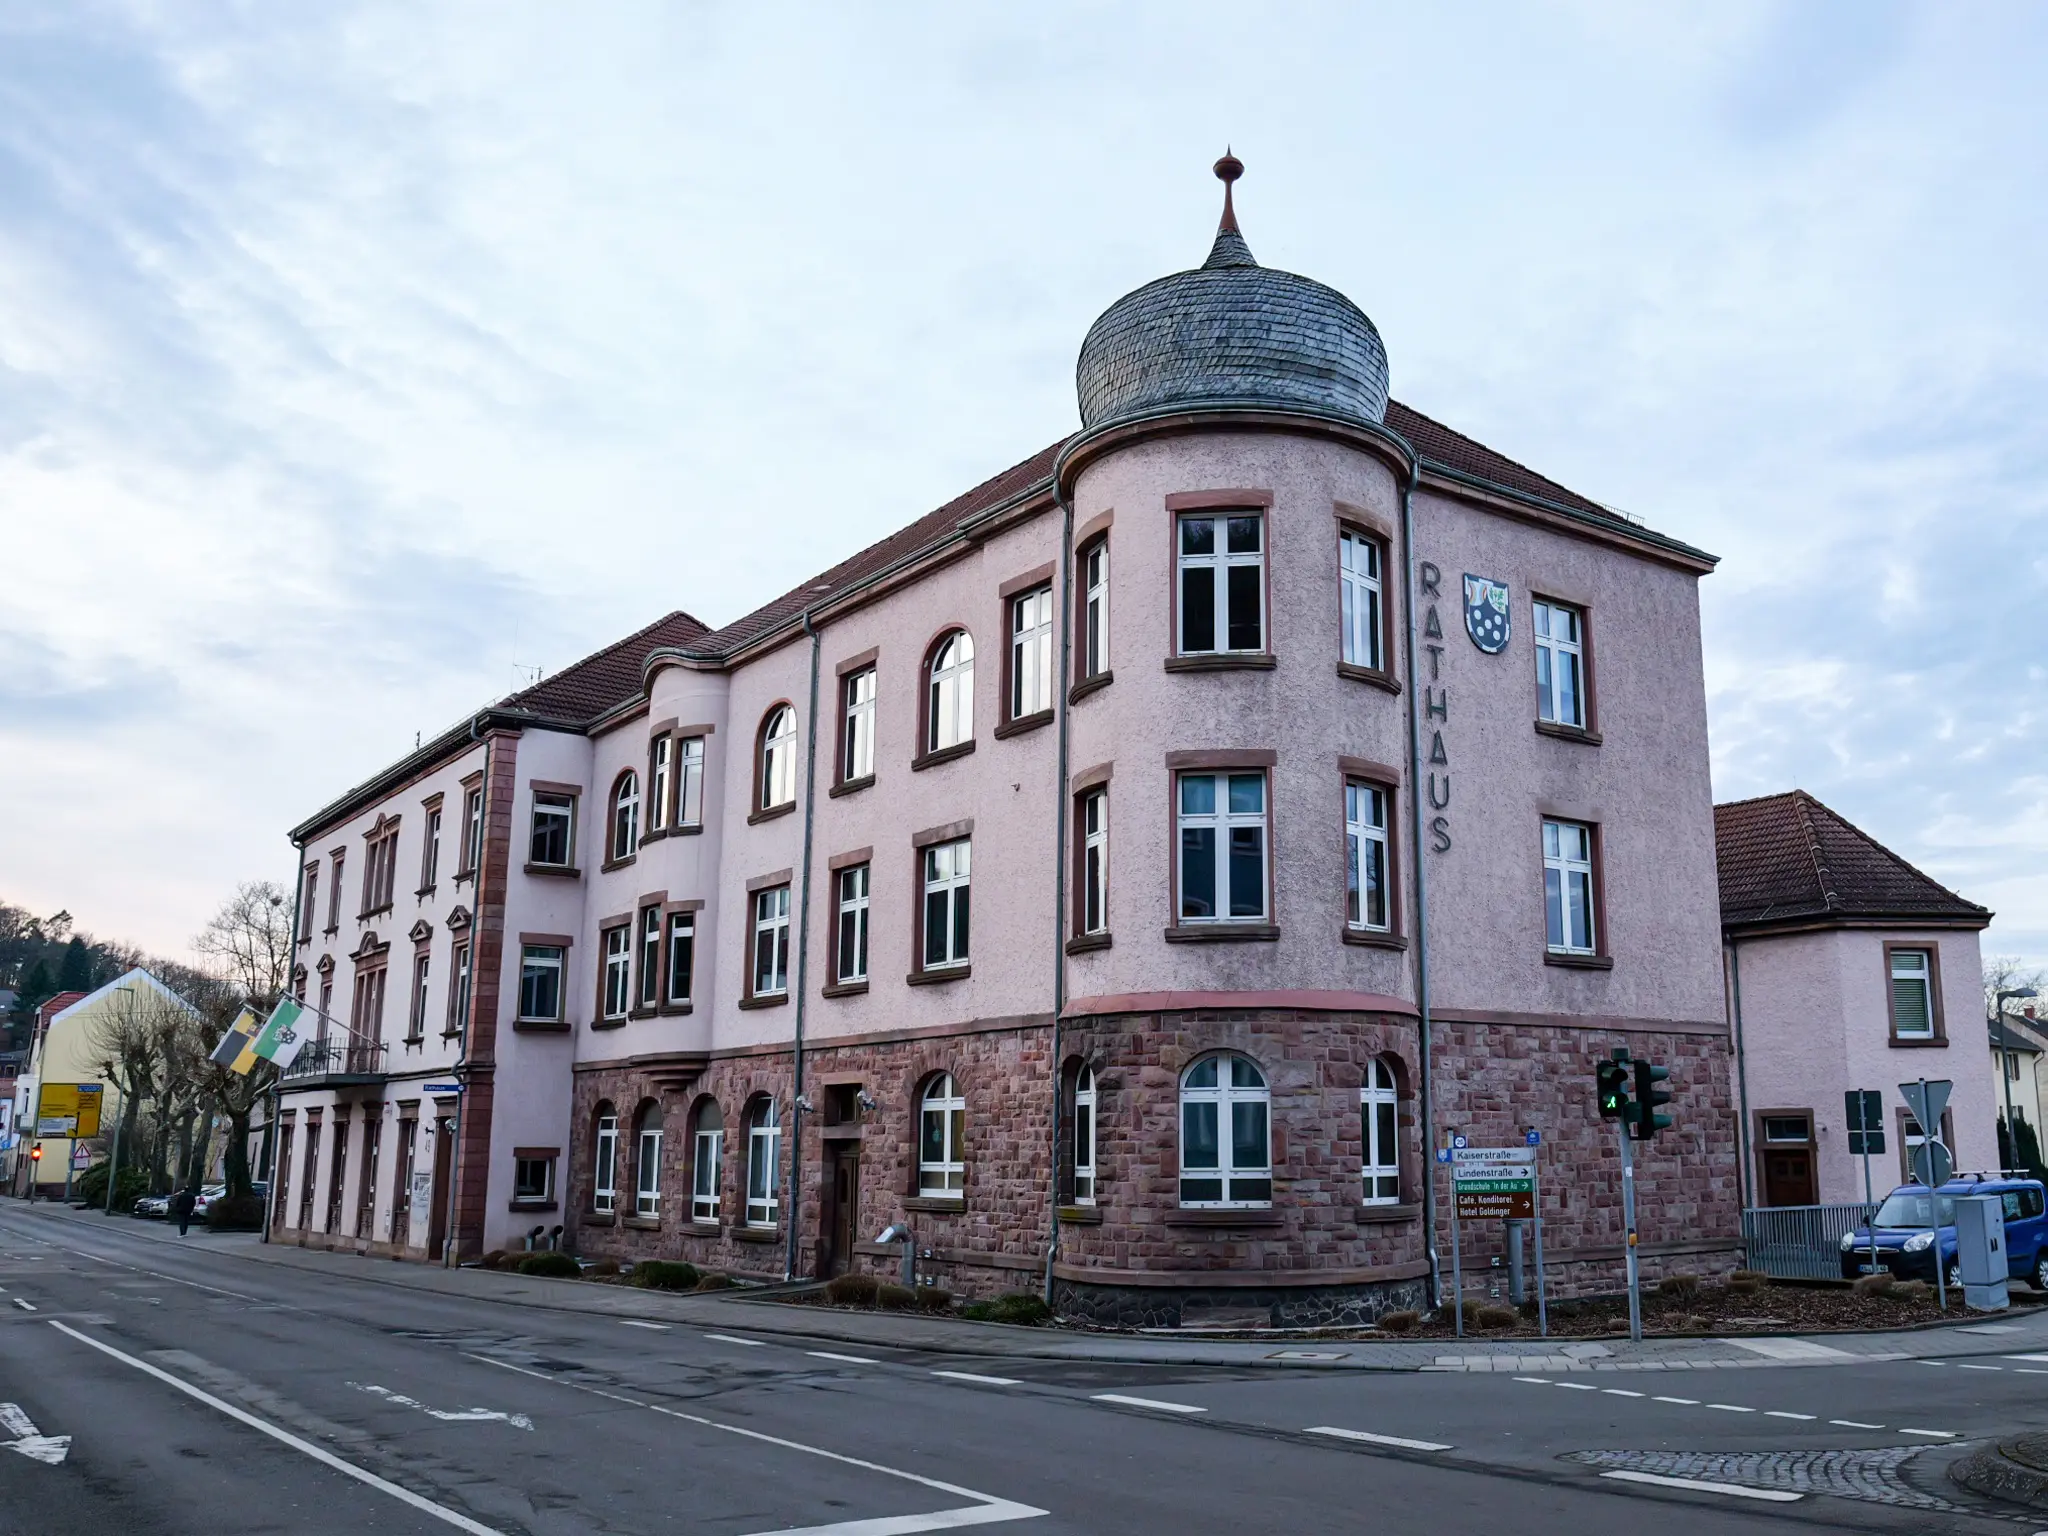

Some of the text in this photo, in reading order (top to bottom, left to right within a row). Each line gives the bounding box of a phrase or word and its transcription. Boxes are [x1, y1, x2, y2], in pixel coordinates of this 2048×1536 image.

[1420, 560, 1452, 854] RATHAUS
[1457, 1150, 1511, 1160] Kaiserstraße
[1458, 1168, 1513, 1178] Lindenstraße
[1457, 1182, 1490, 1191] Grundschule
[1500, 1181, 1509, 1190] der
[1459, 1207, 1511, 1218] Hotel Goldinger
